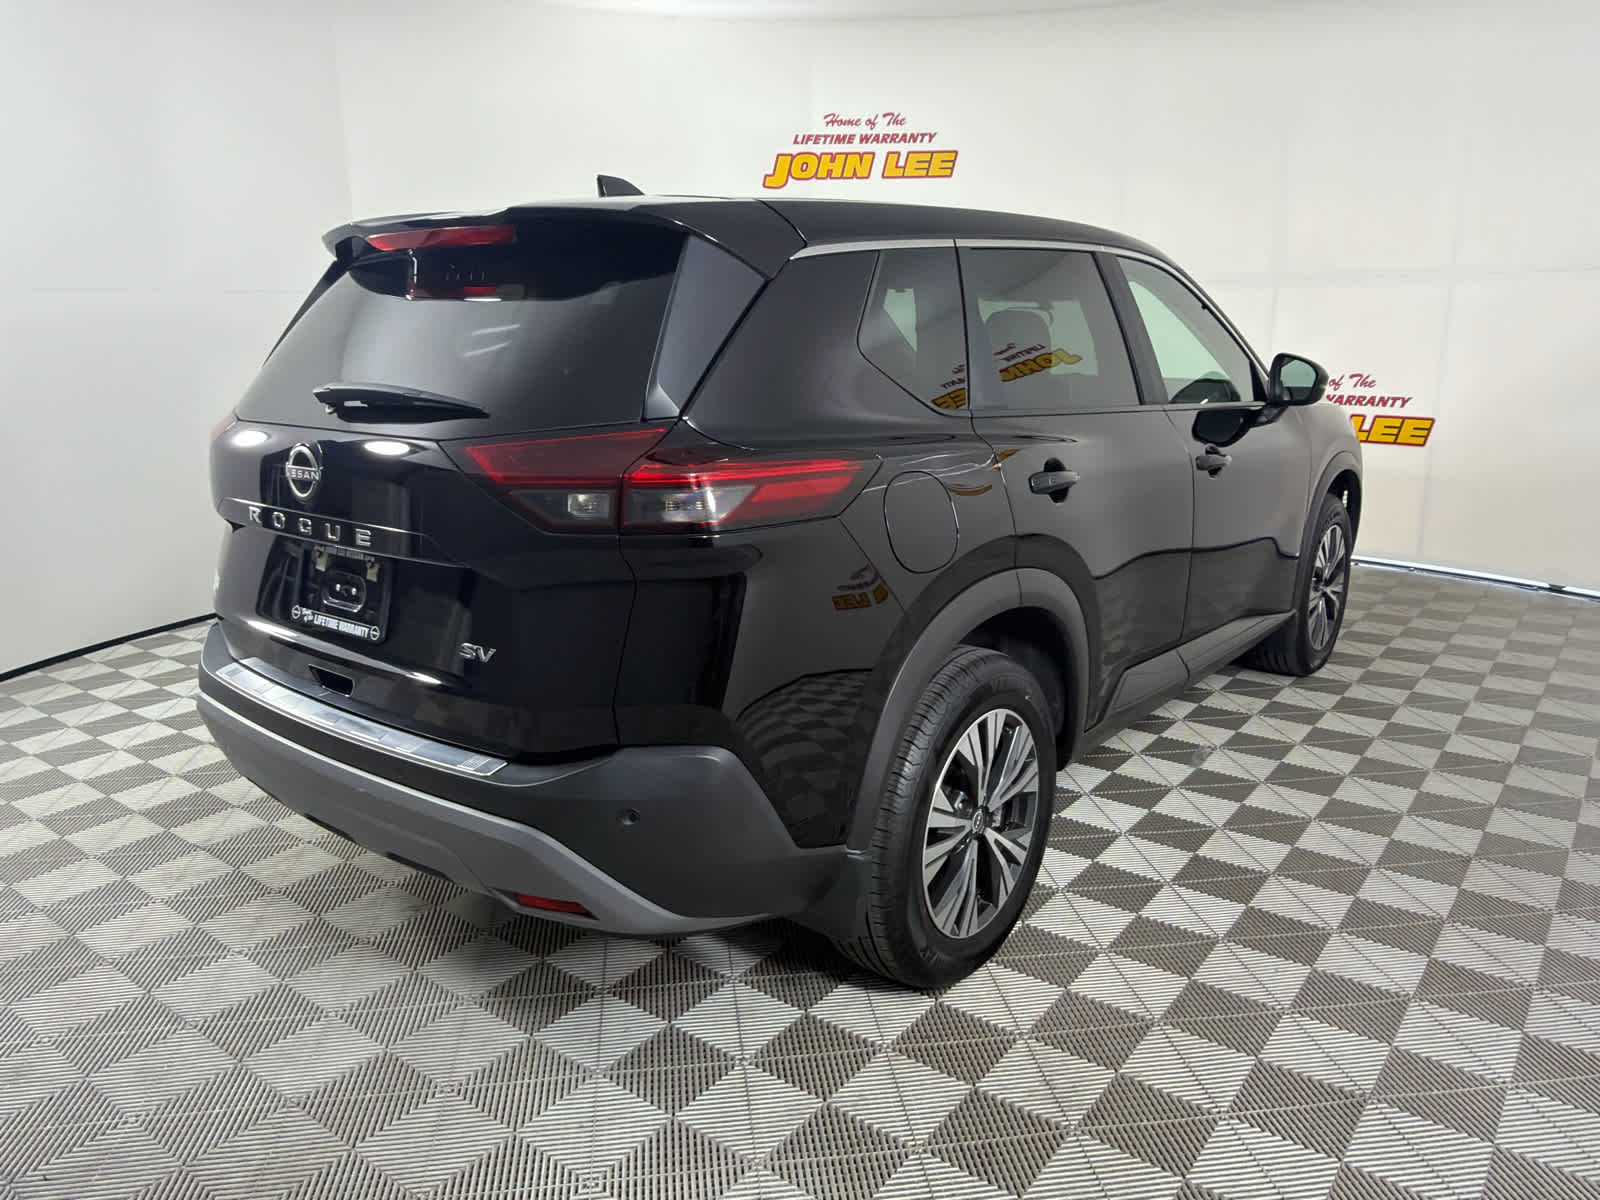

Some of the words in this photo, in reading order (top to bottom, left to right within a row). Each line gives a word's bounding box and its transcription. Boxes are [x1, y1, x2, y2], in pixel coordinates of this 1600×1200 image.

[823, 113, 861, 127] Home
[865, 114, 878, 130] of
[882, 112, 906, 126] The
[793, 134, 855, 145] LIFETIME
[859, 132, 937, 144] WARRANTY
[763, 151, 875, 189] JOHN
[881, 150, 958, 178] LEE
[1328, 374, 1345, 391] of
[1349, 373, 1377, 388] The
[1350, 414, 1435, 447] LEE
[248, 506, 371, 547] ROGUE
[459, 642, 497, 663] SV
